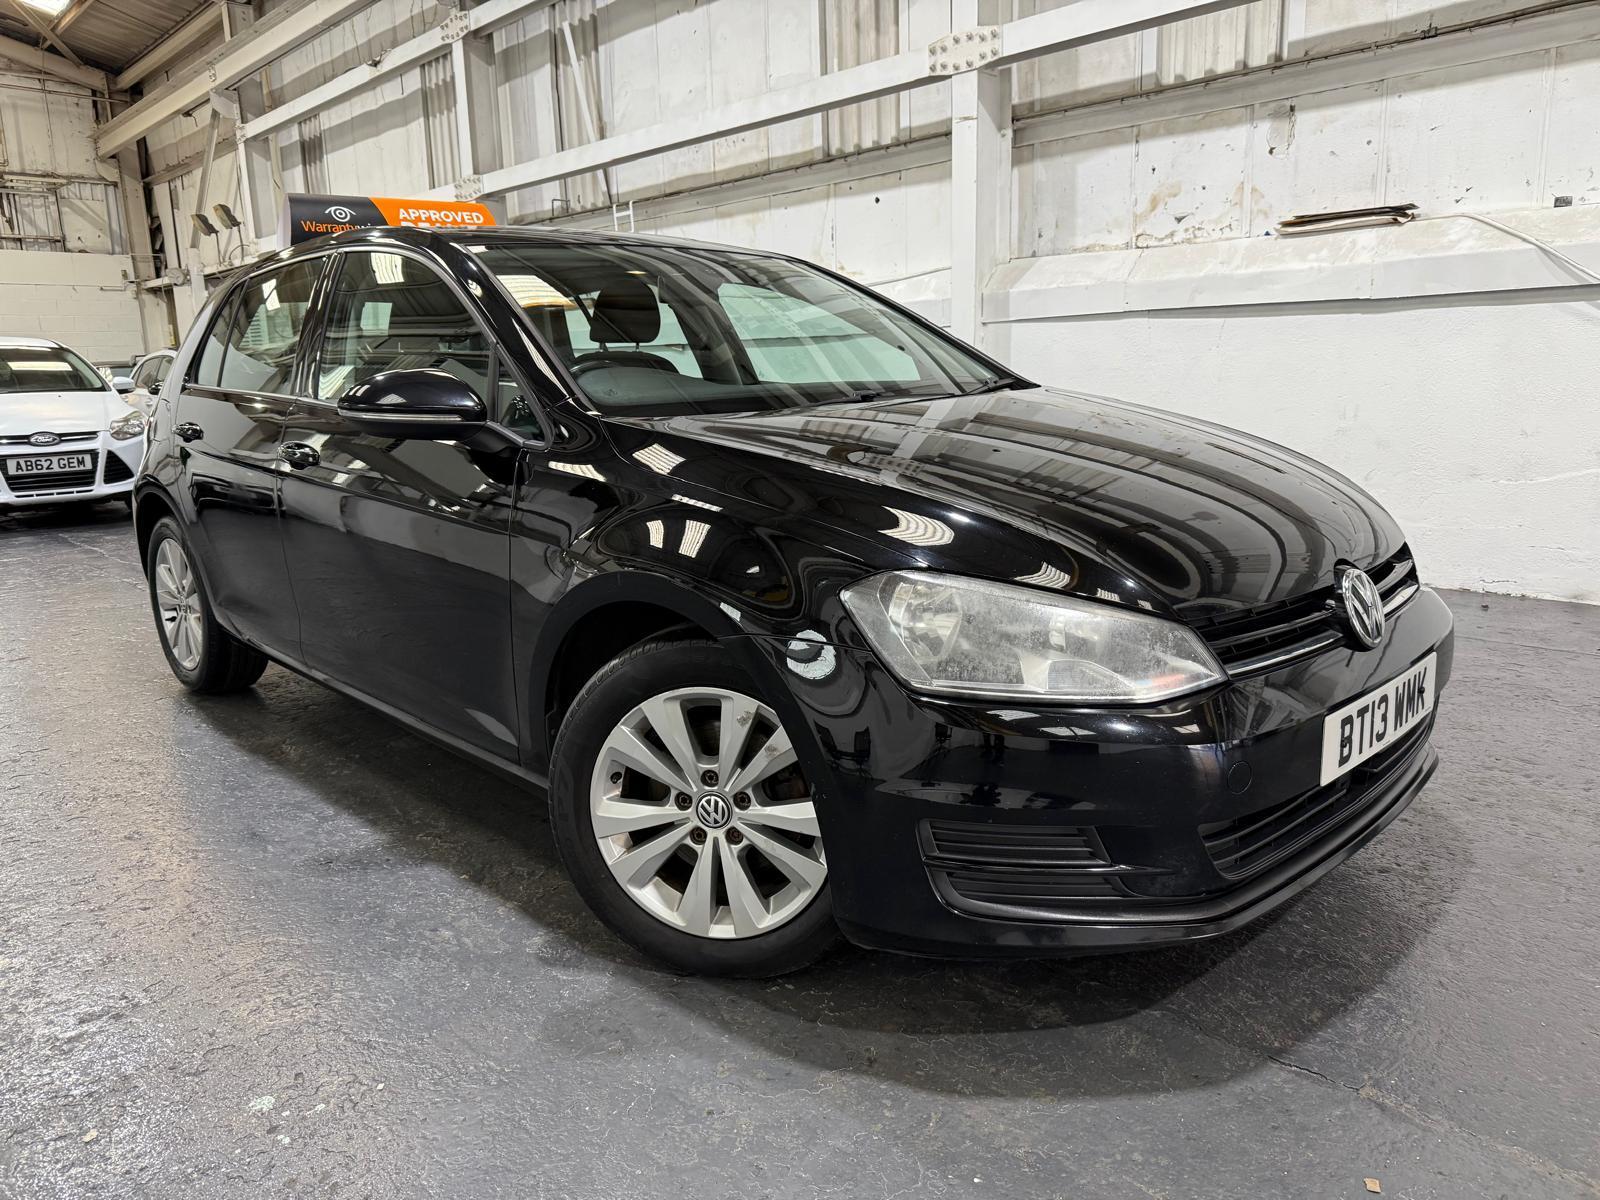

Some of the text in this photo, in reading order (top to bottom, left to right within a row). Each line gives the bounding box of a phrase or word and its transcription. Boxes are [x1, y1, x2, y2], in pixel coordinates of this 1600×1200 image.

[399, 208, 484, 224] APPROVED
[15, 456, 86, 473] AB62 GEM
[1338, 666, 1427, 768] BT13 WMK
